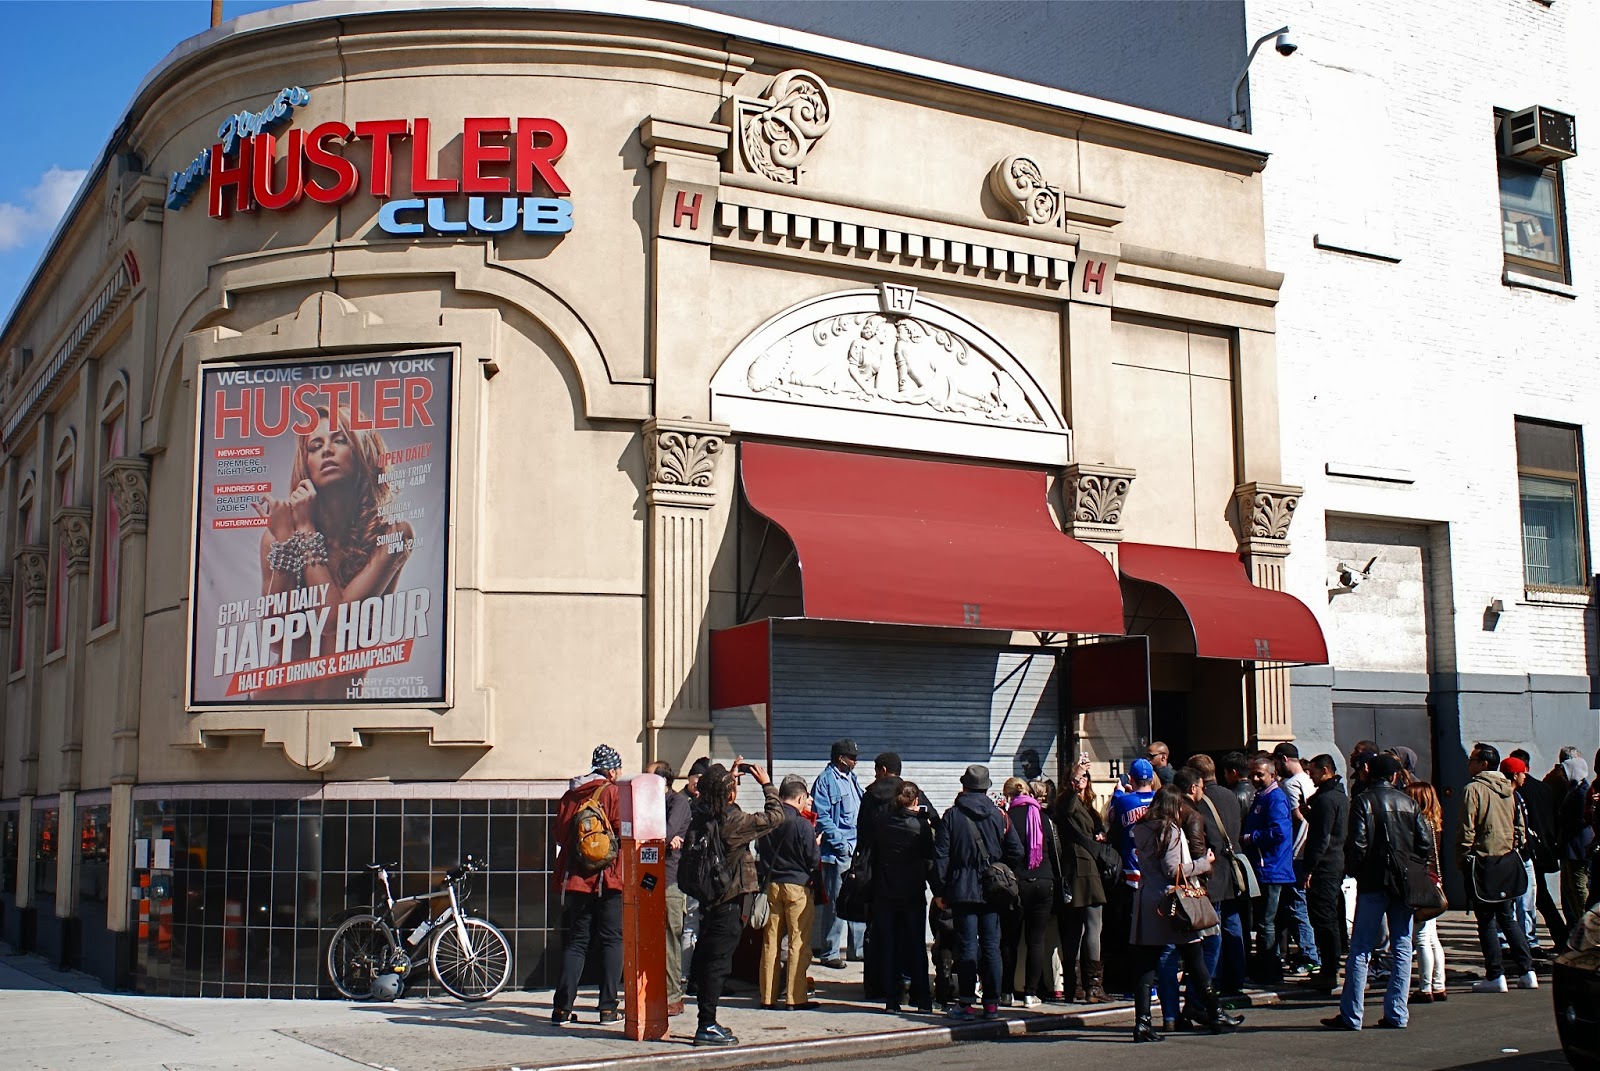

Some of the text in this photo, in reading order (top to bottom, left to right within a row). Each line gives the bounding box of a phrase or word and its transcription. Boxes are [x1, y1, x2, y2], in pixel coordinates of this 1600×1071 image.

[208, 117, 572, 220] HUSTLER
[378, 197, 575, 235] CLUB
[673, 190, 703, 231] H
[1082, 260, 1107, 295] H
[217, 358, 435, 386] WELCOME TO NEW YORK
[214, 376, 435, 440] HUSTLER
[218, 458, 261, 468] PREMIERE
[378, 442, 433, 468] OPEN DAILY
[217, 465, 268, 476] NIGHT SPOT
[378, 463, 432, 485] MONDAY FRIDAY
[216, 484, 268, 494] HUNDREDS OF
[217, 495, 262, 505] BEAUTIFUL
[216, 504, 248, 513] LADIES!
[377, 500, 411, 517] SATURDAY
[215, 518, 268, 528] HUSTLERNY.COM
[376, 531, 404, 546] SUNDAY
[290, 583, 330, 612] DAILY
[214, 587, 431, 677] HAPPY HOUR
[237, 643, 405, 692] HALF OFF DRINKS & CHAMPAGNE
[346, 685, 429, 699] HUSTLER CLUB
[351, 677, 383, 687] LARRY
